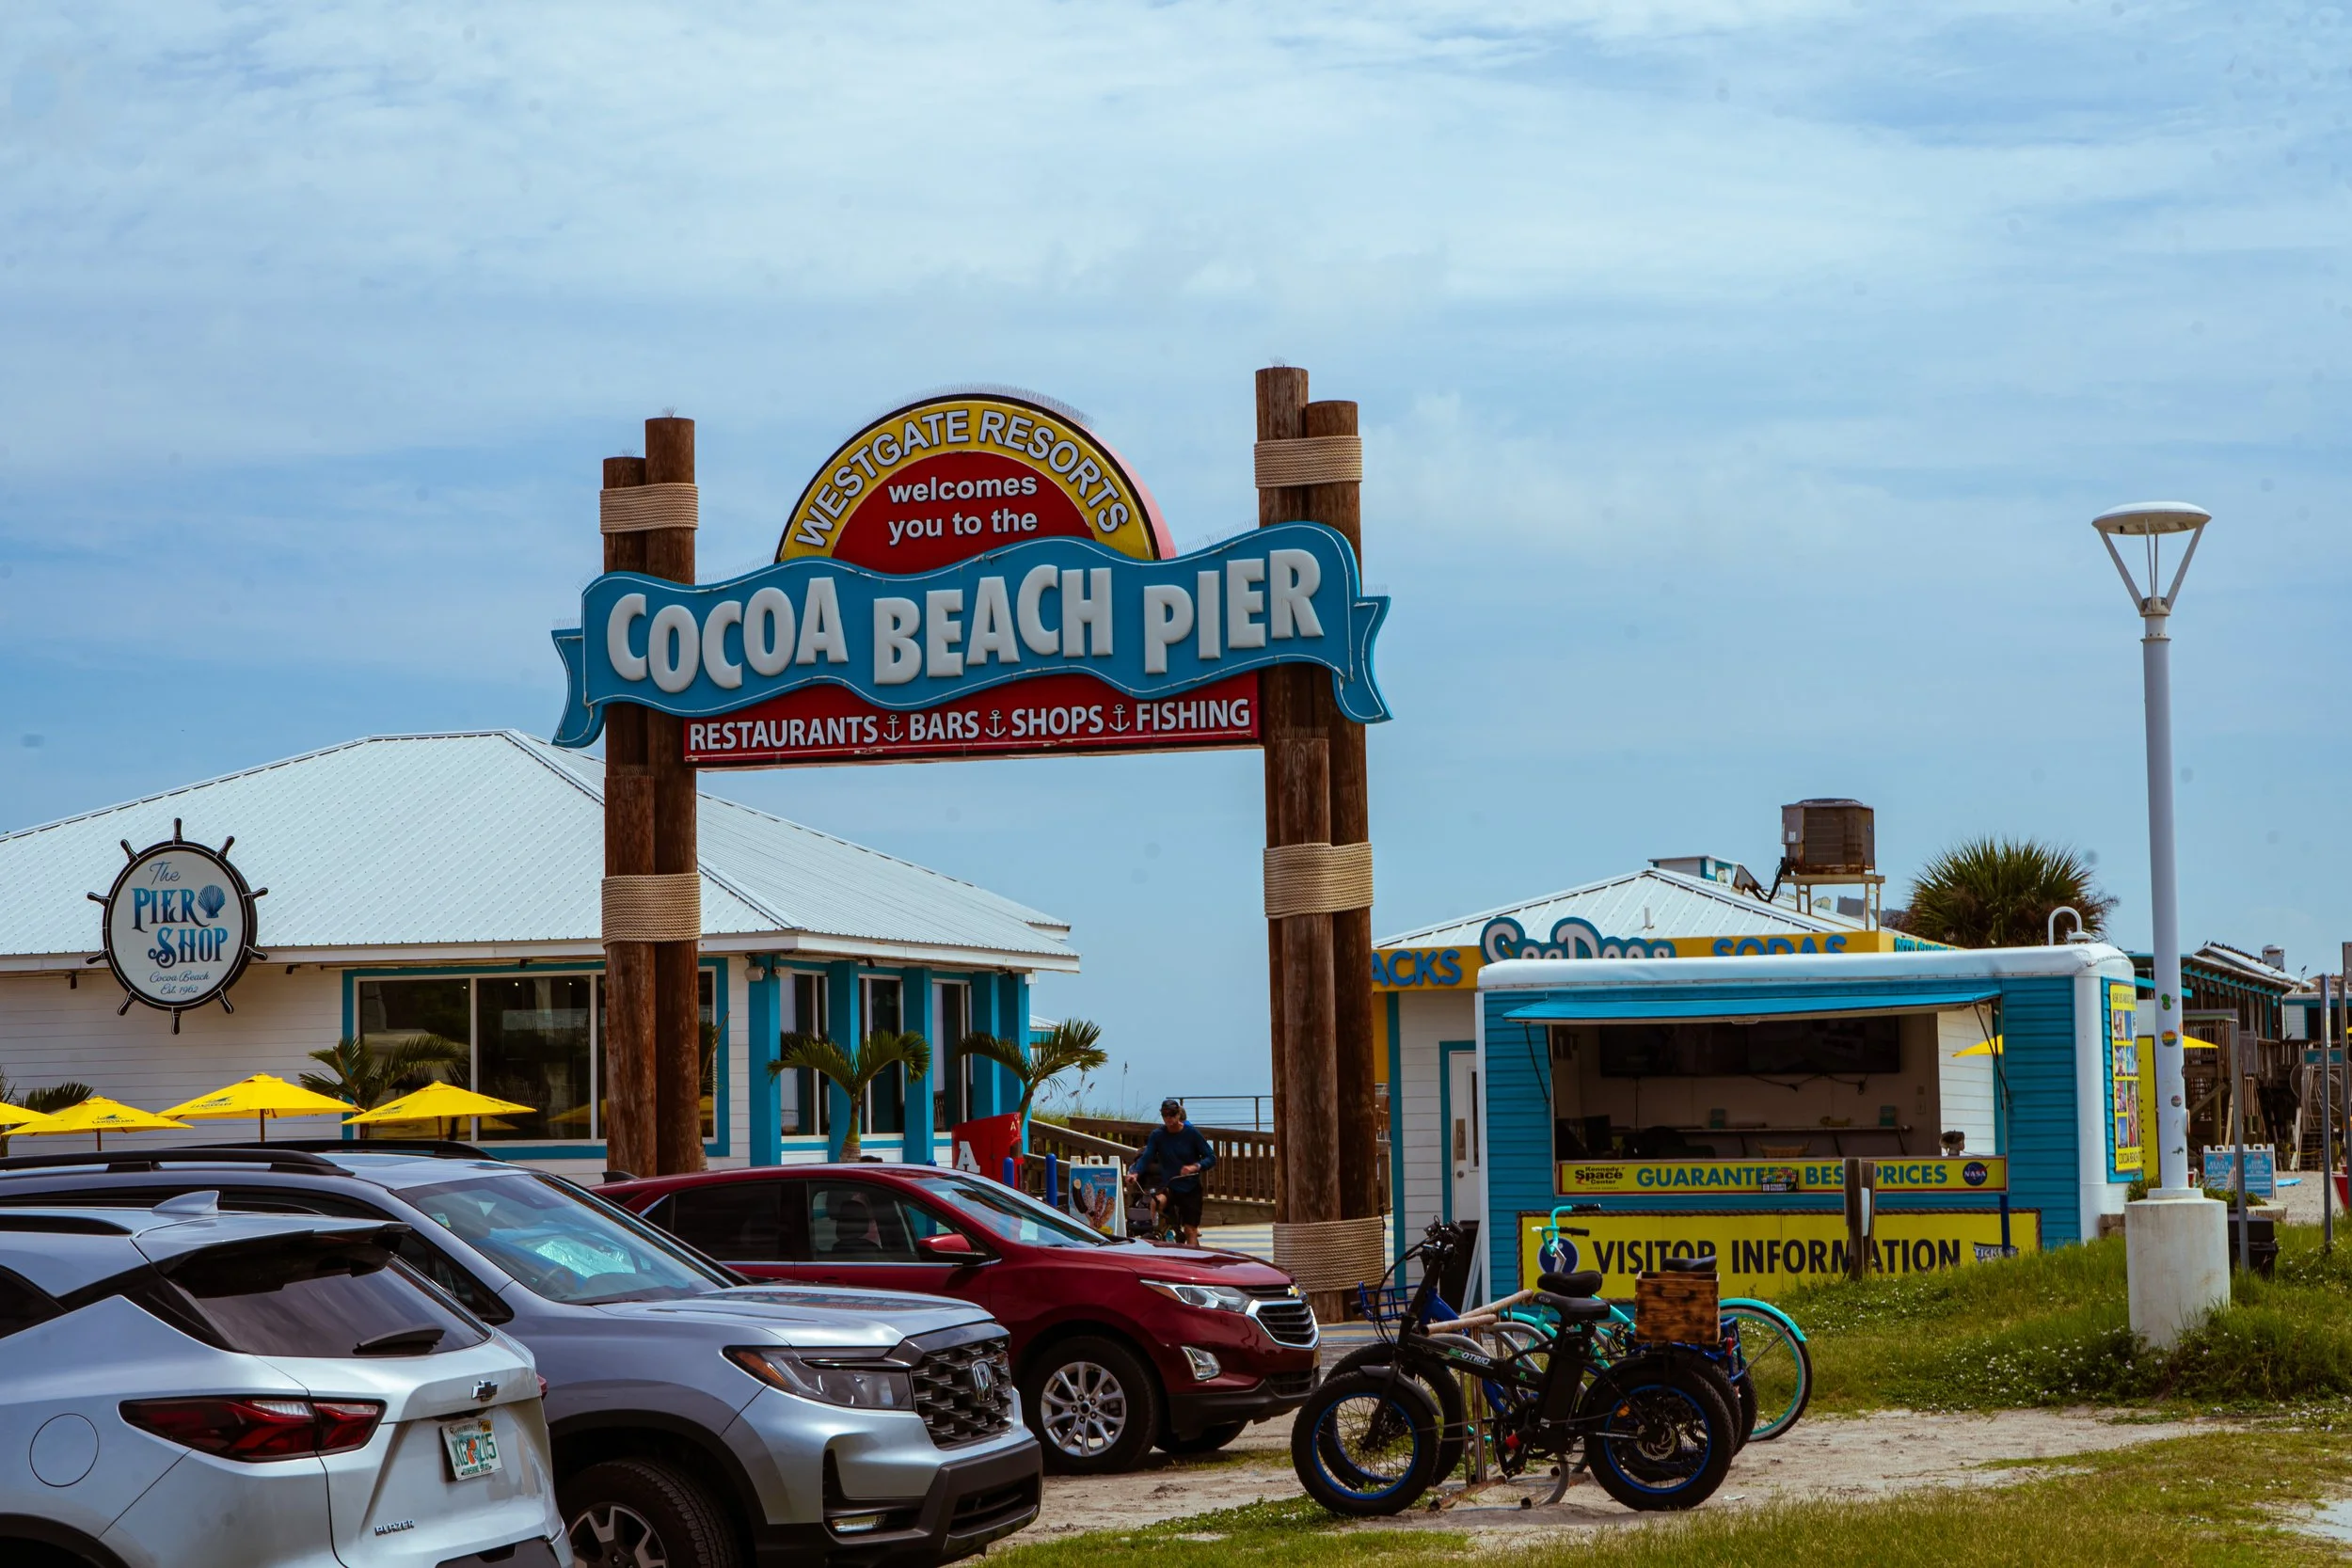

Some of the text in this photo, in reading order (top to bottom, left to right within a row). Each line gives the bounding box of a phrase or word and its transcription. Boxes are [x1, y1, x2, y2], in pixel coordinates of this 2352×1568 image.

[795, 409, 1129, 548] WESTGATE RESORTS
[887, 476, 1039, 504] welcomes
[887, 508, 1039, 546] you to the
[607, 548, 1325, 694] COCOA BEACH PIER
[689, 698, 1251, 752] RESTAURANTS BARS SHOPS FISHING
[149, 861, 181, 886] The
[131, 887, 211, 933] PIER
[148, 927, 229, 969] SHOP
[150, 970, 210, 984] Cocoa Beach
[160, 984, 199, 995] Est. 1962
[1575, 1169, 1623, 1181] Space
[1805, 1165, 1844, 1185] BES
